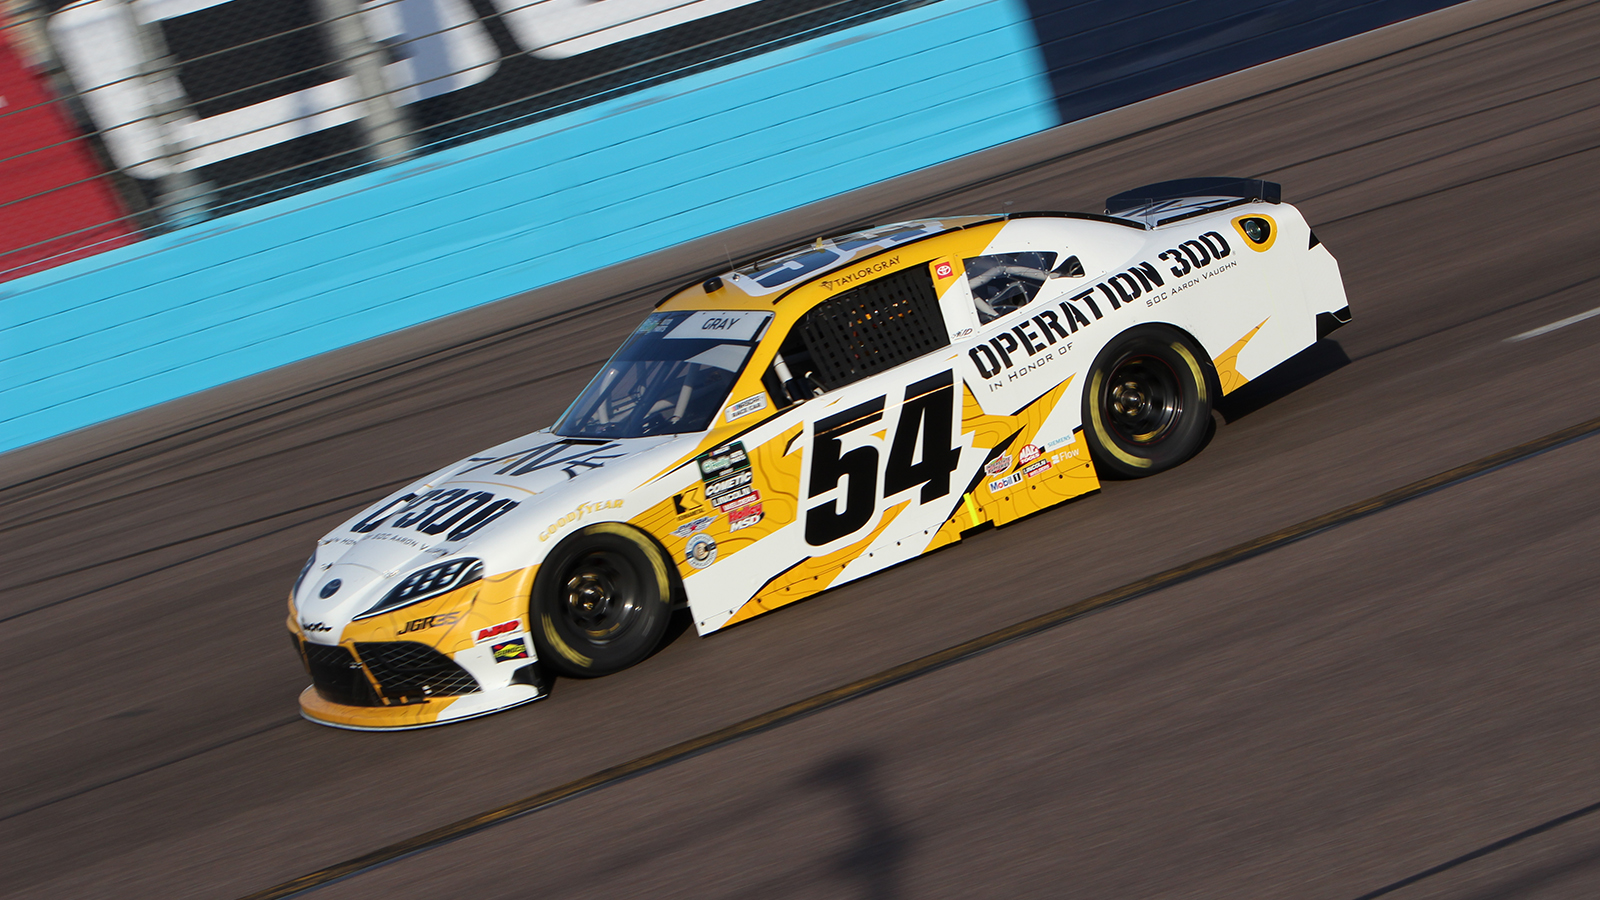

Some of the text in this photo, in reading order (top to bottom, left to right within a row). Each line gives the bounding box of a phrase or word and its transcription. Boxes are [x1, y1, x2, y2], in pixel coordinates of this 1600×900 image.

[834, 255, 901, 287] TAYLOR GRAY
[1146, 261, 1237, 307] SOC AARON VAUGHN
[968, 231, 1231, 380] OPERATION 300
[701, 318, 740, 330] GRAY
[988, 341, 1074, 393] IN HONOR OF
[1020, 445, 1040, 461] MAC
[1047, 434, 1072, 448] SIEMENS
[1059, 448, 1080, 461] Flow
[805, 369, 963, 546] 54
[705, 472, 752, 496] COMETIC
[990, 476, 1013, 491] Mobil
[538, 499, 625, 542] GOODYEAR
